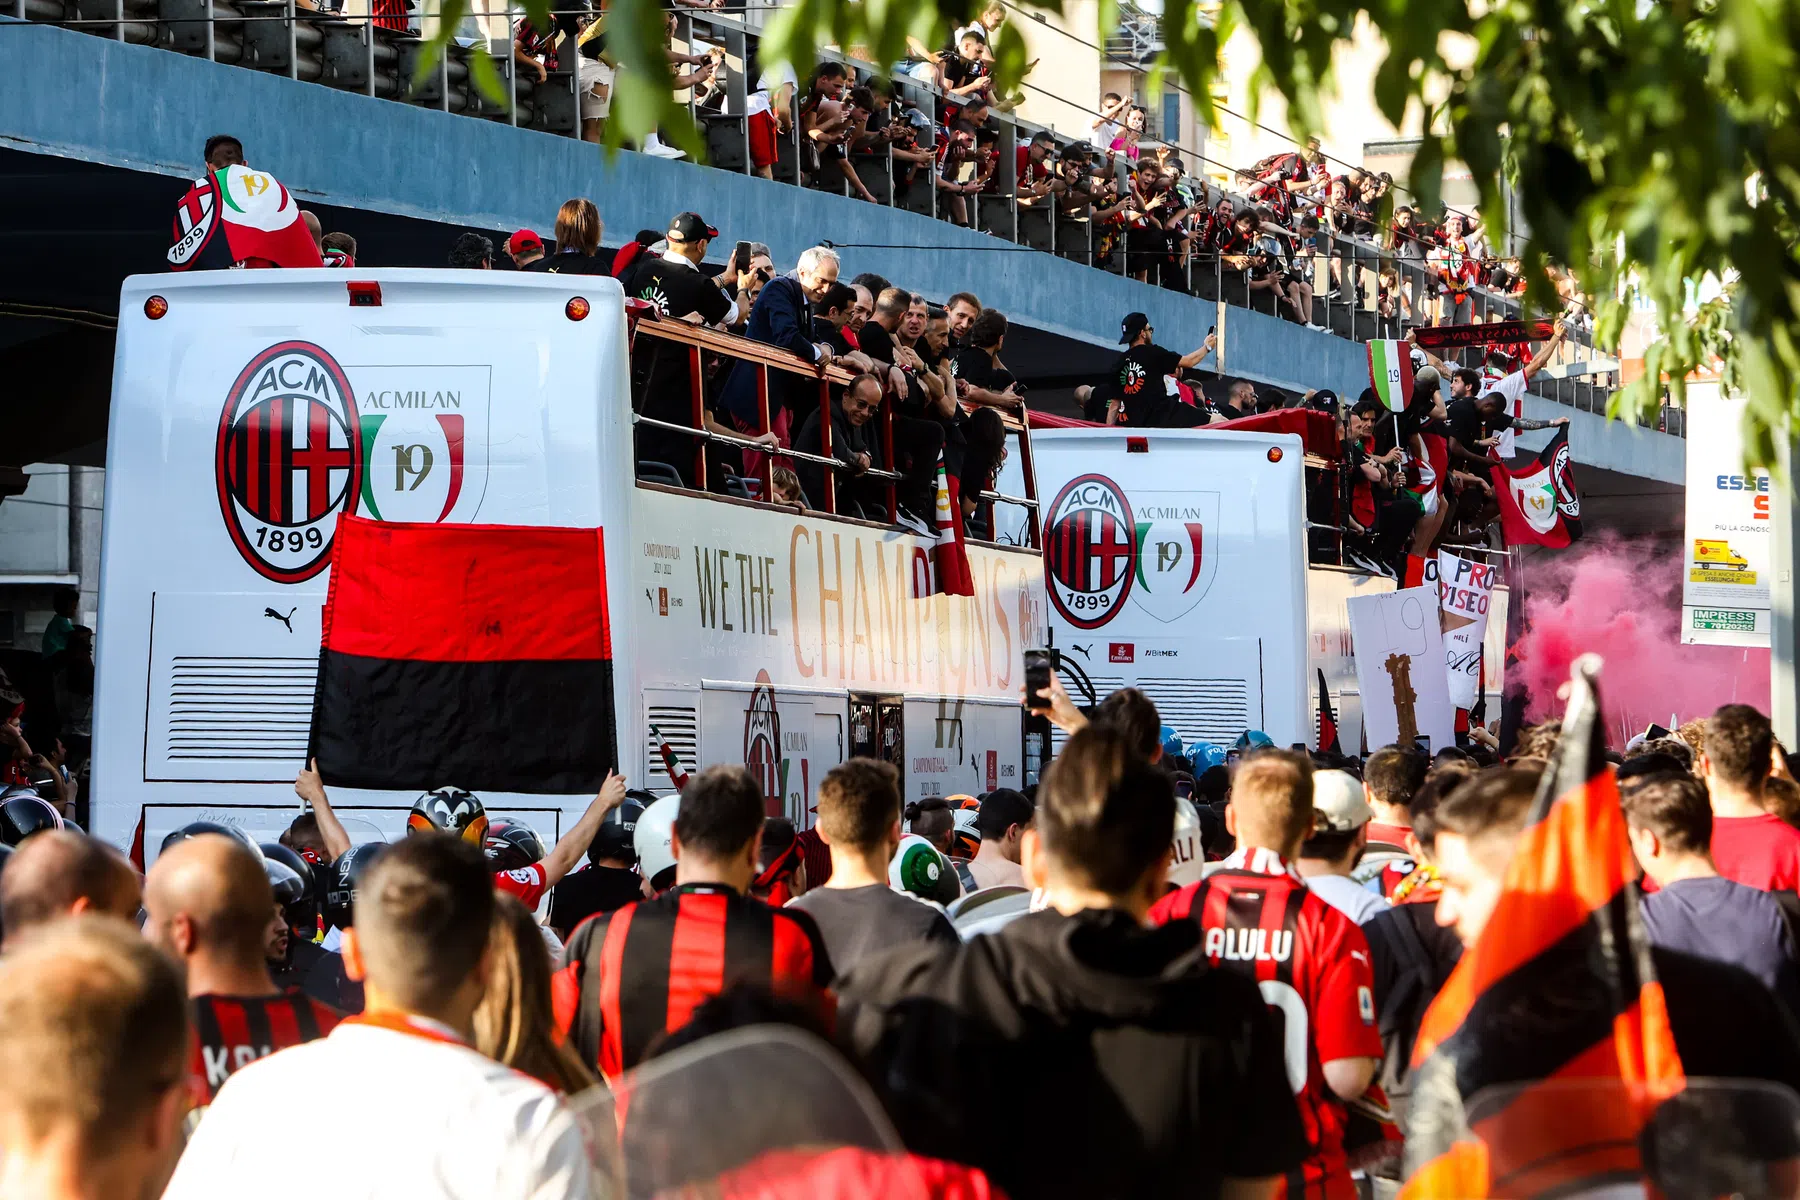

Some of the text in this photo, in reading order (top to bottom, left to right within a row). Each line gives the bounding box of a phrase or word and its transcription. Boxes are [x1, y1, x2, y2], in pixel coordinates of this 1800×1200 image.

[239, 174, 270, 197] 19
[171, 227, 204, 261] 1899
[250, 359, 331, 403] ACM
[1388, 369, 1400, 383] 19
[391, 443, 434, 492] 19
[1064, 485, 1117, 514] ACM
[255, 526, 323, 553] 1899
[1155, 541, 1183, 572] 19
[1454, 558, 1496, 591] PRO
[694, 545, 733, 632] WE
[735, 552, 778, 637] THE
[1065, 591, 1110, 611] 1899
[1694, 610, 1755, 621] IMPRESS
[1711, 622, 1754, 631] 70120255
